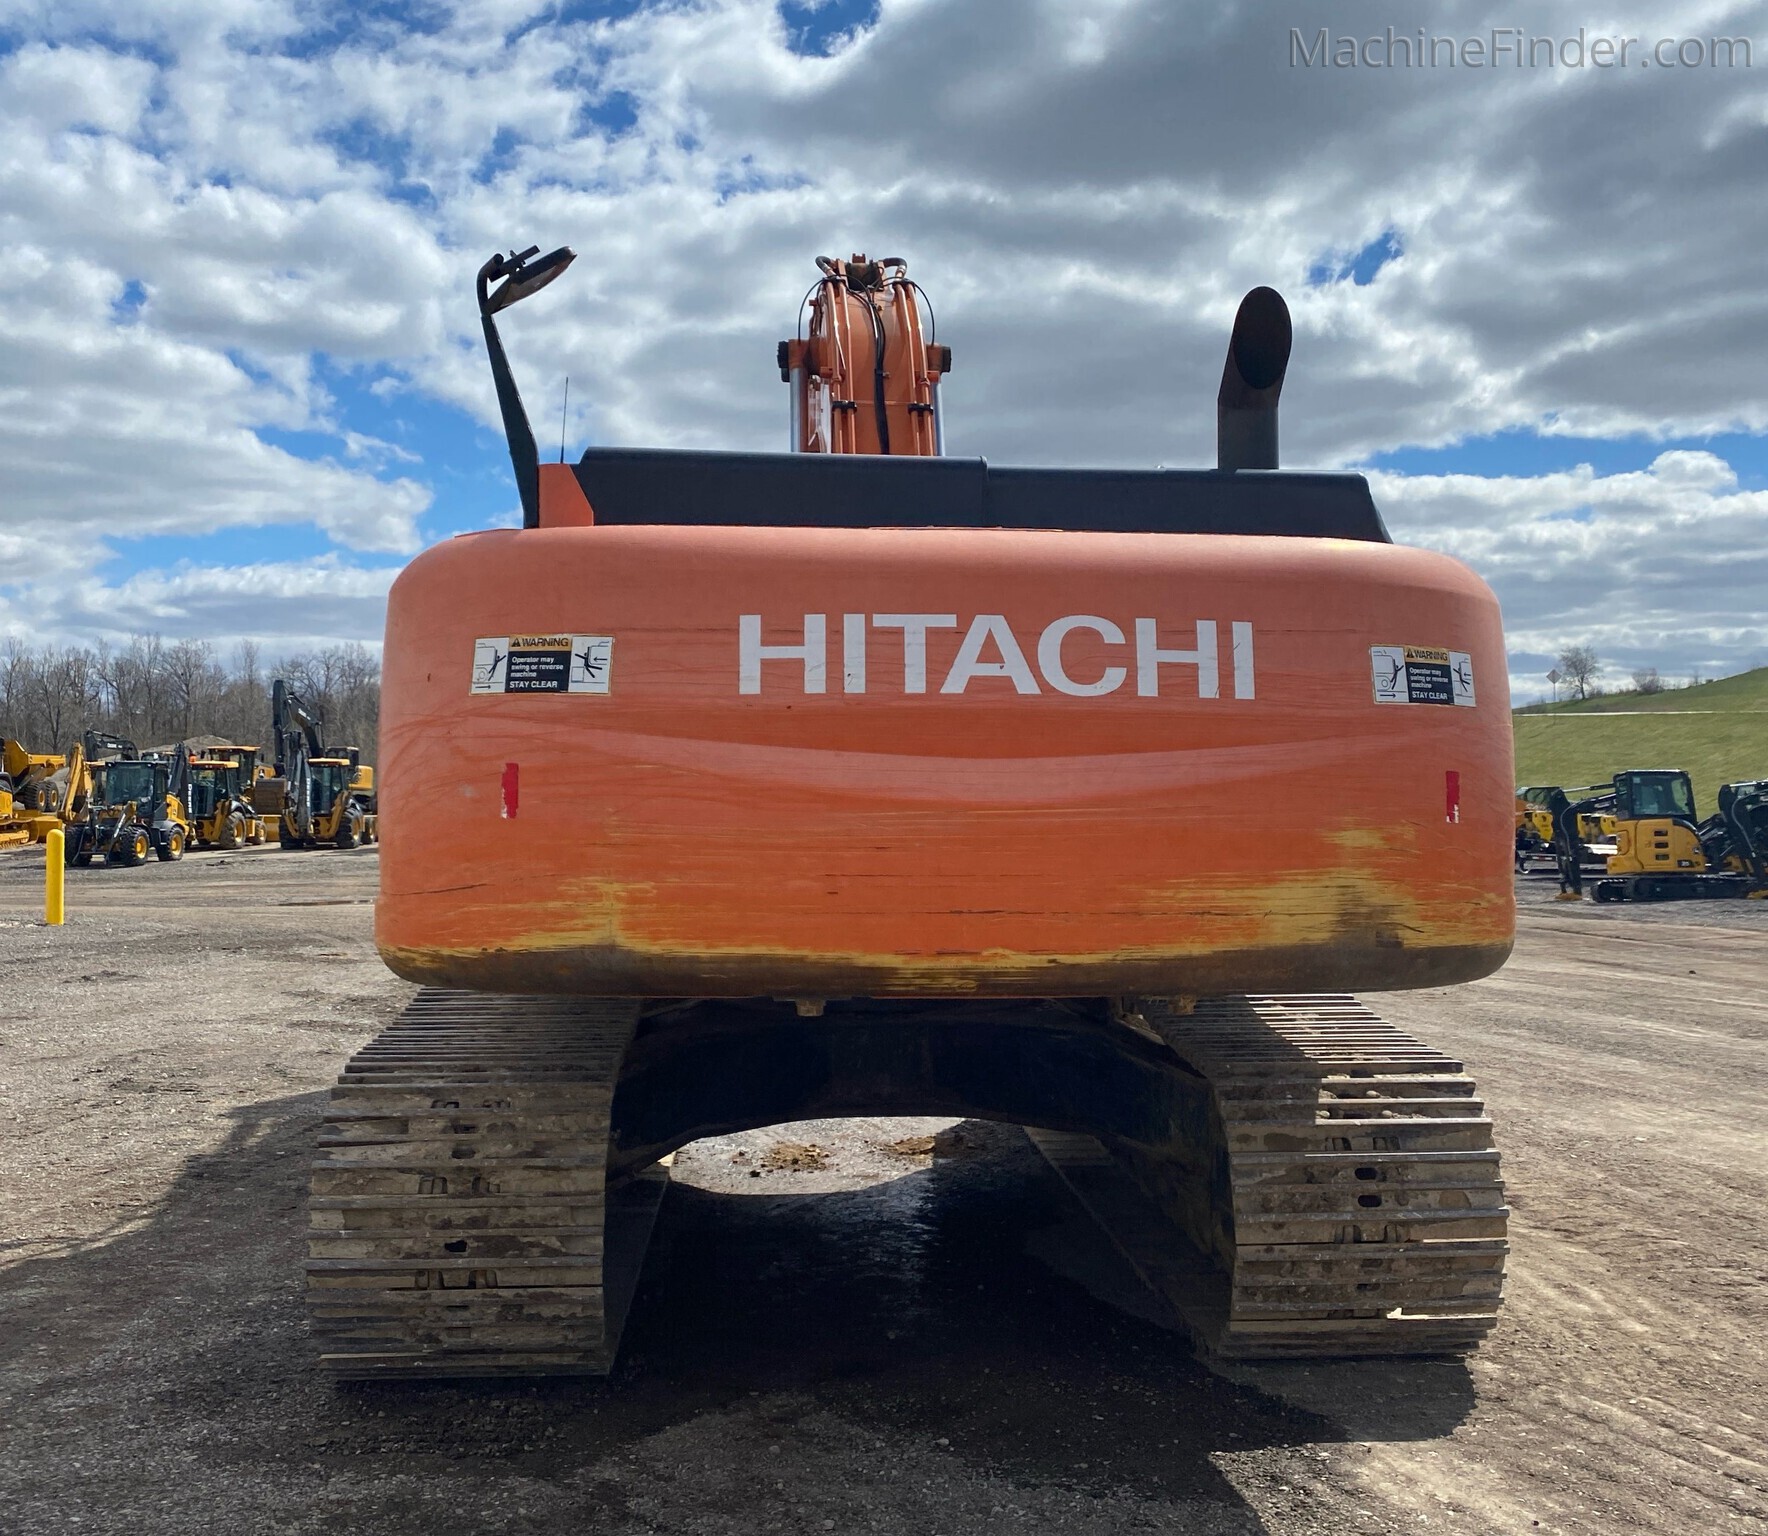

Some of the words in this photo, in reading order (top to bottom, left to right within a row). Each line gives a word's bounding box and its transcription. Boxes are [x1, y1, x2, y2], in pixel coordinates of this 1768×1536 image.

[522, 637, 569, 647] WARNING
[739, 613, 1255, 699] HITACHI
[1414, 650, 1448, 661] WARNING
[530, 680, 558, 688] CLEAR
[1428, 691, 1448, 700] CLEAR
